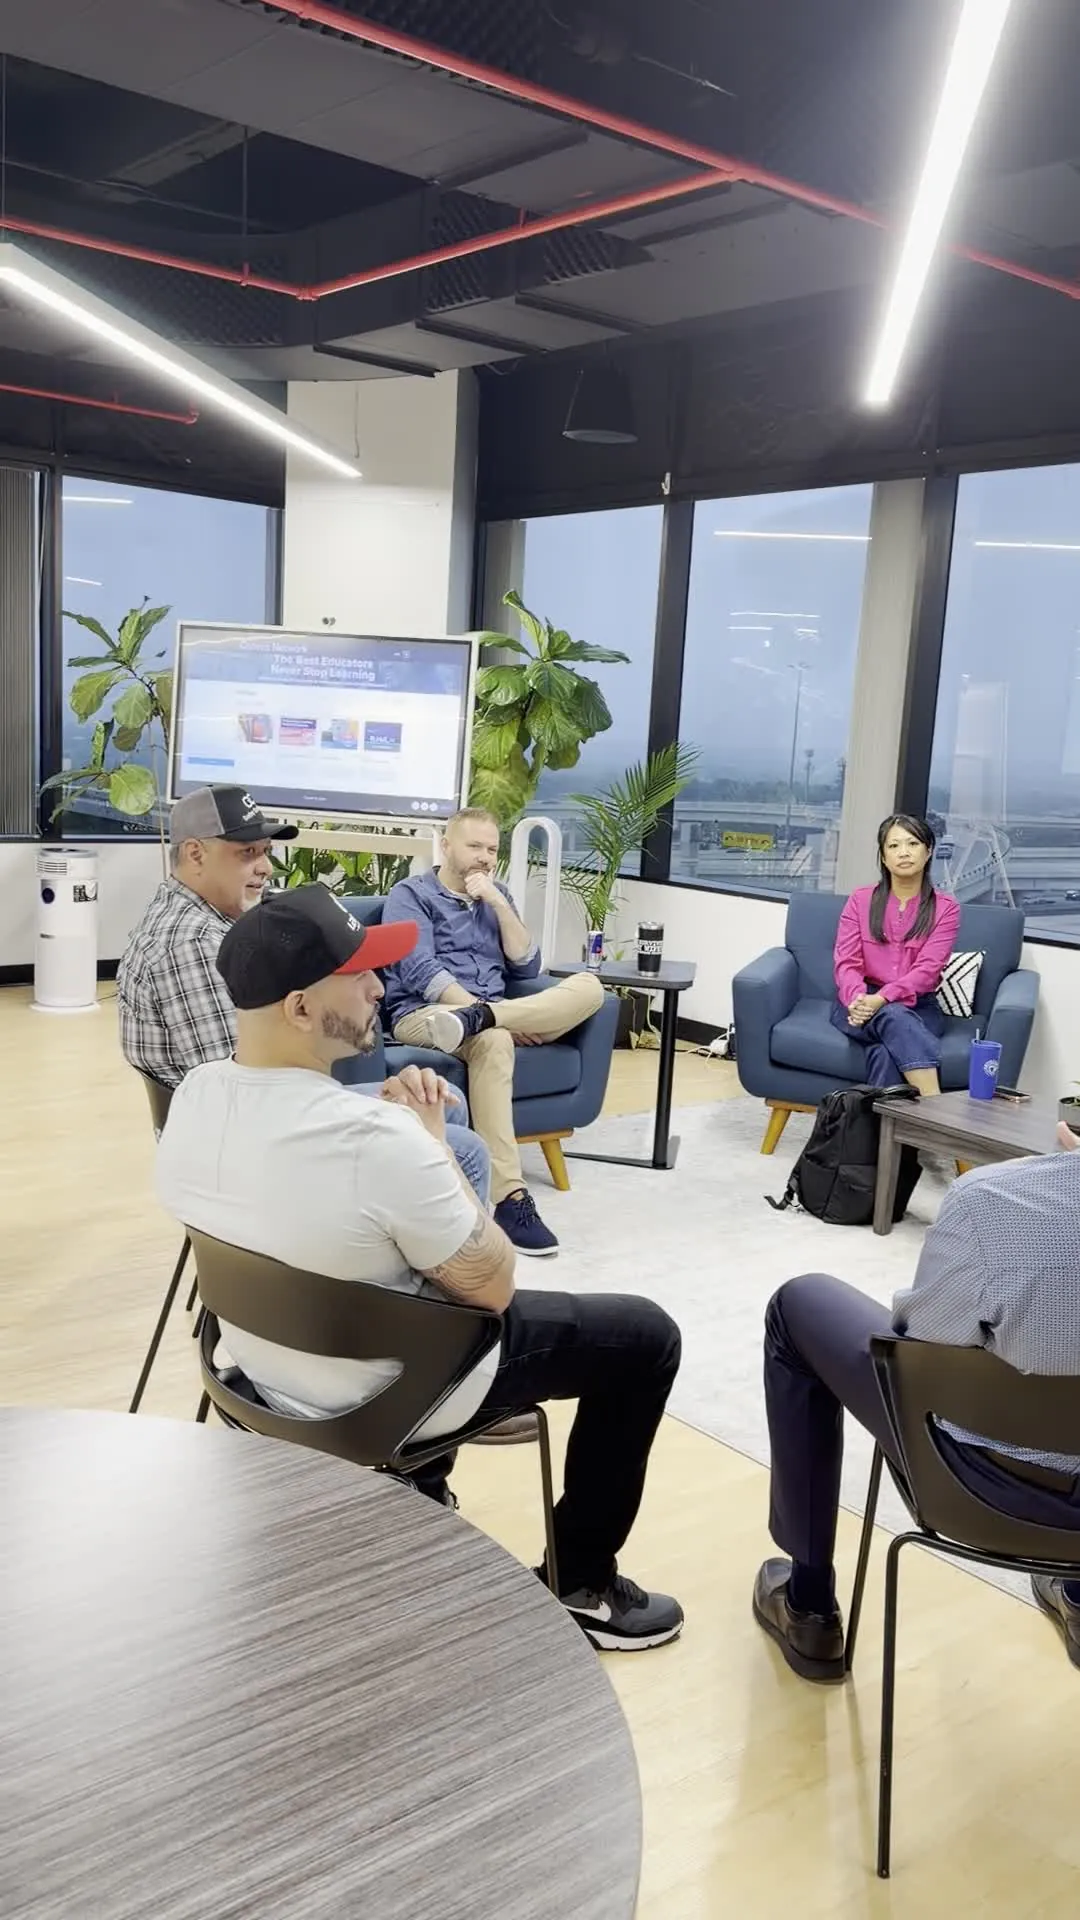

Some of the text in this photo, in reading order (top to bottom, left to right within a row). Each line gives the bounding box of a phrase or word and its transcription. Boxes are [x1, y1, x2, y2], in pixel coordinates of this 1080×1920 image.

[273, 654, 374, 668] The Best Educators
[270, 664, 376, 681] Never Stop Learning
